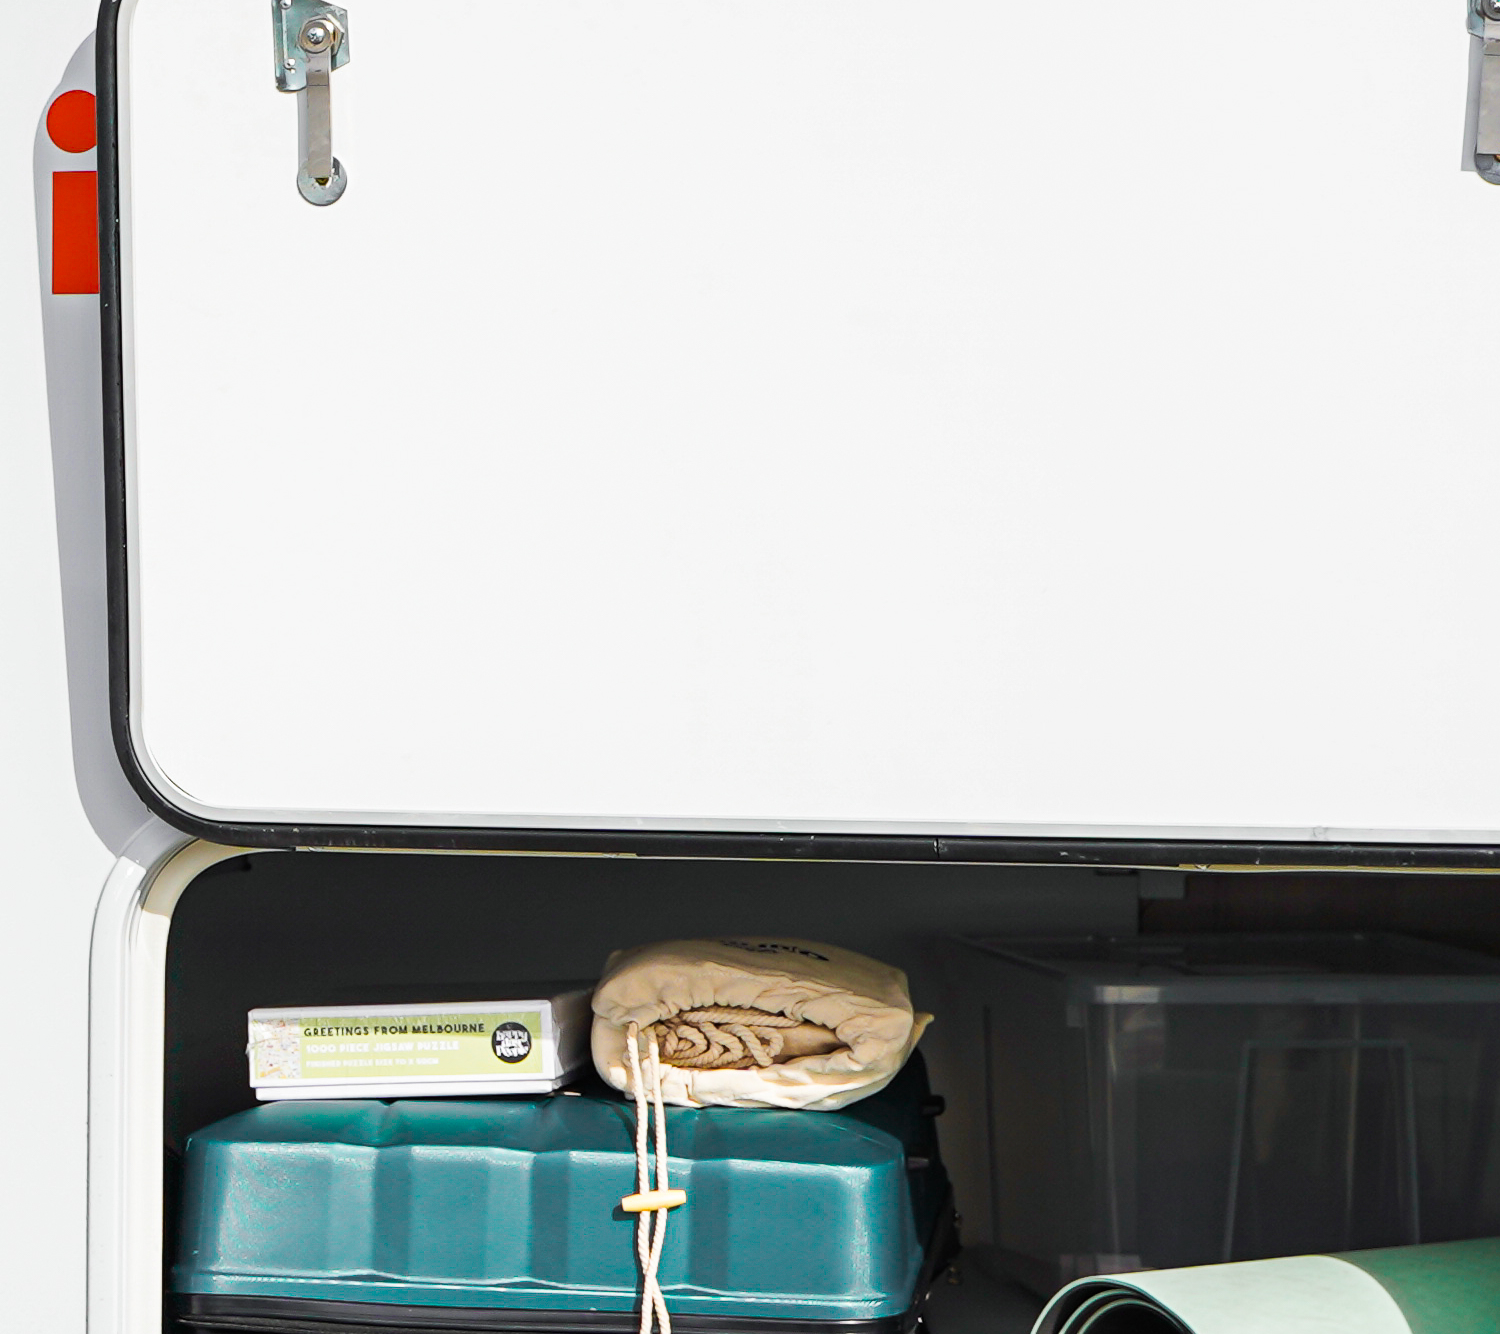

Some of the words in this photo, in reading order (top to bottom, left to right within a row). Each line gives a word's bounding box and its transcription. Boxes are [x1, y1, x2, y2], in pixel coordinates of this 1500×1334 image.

[303, 1025, 370, 1037] GREETINGS
[374, 1025, 408, 1035] FROM
[412, 1023, 485, 1035] MELBOURNE
[305, 1044, 336, 1053] 1000
[339, 1043, 370, 1052] PIECE
[374, 1042, 414, 1052] JIGSAW
[417, 1041, 459, 1050] PUZZLE
[343, 1059, 373, 1067] PUZZLE
